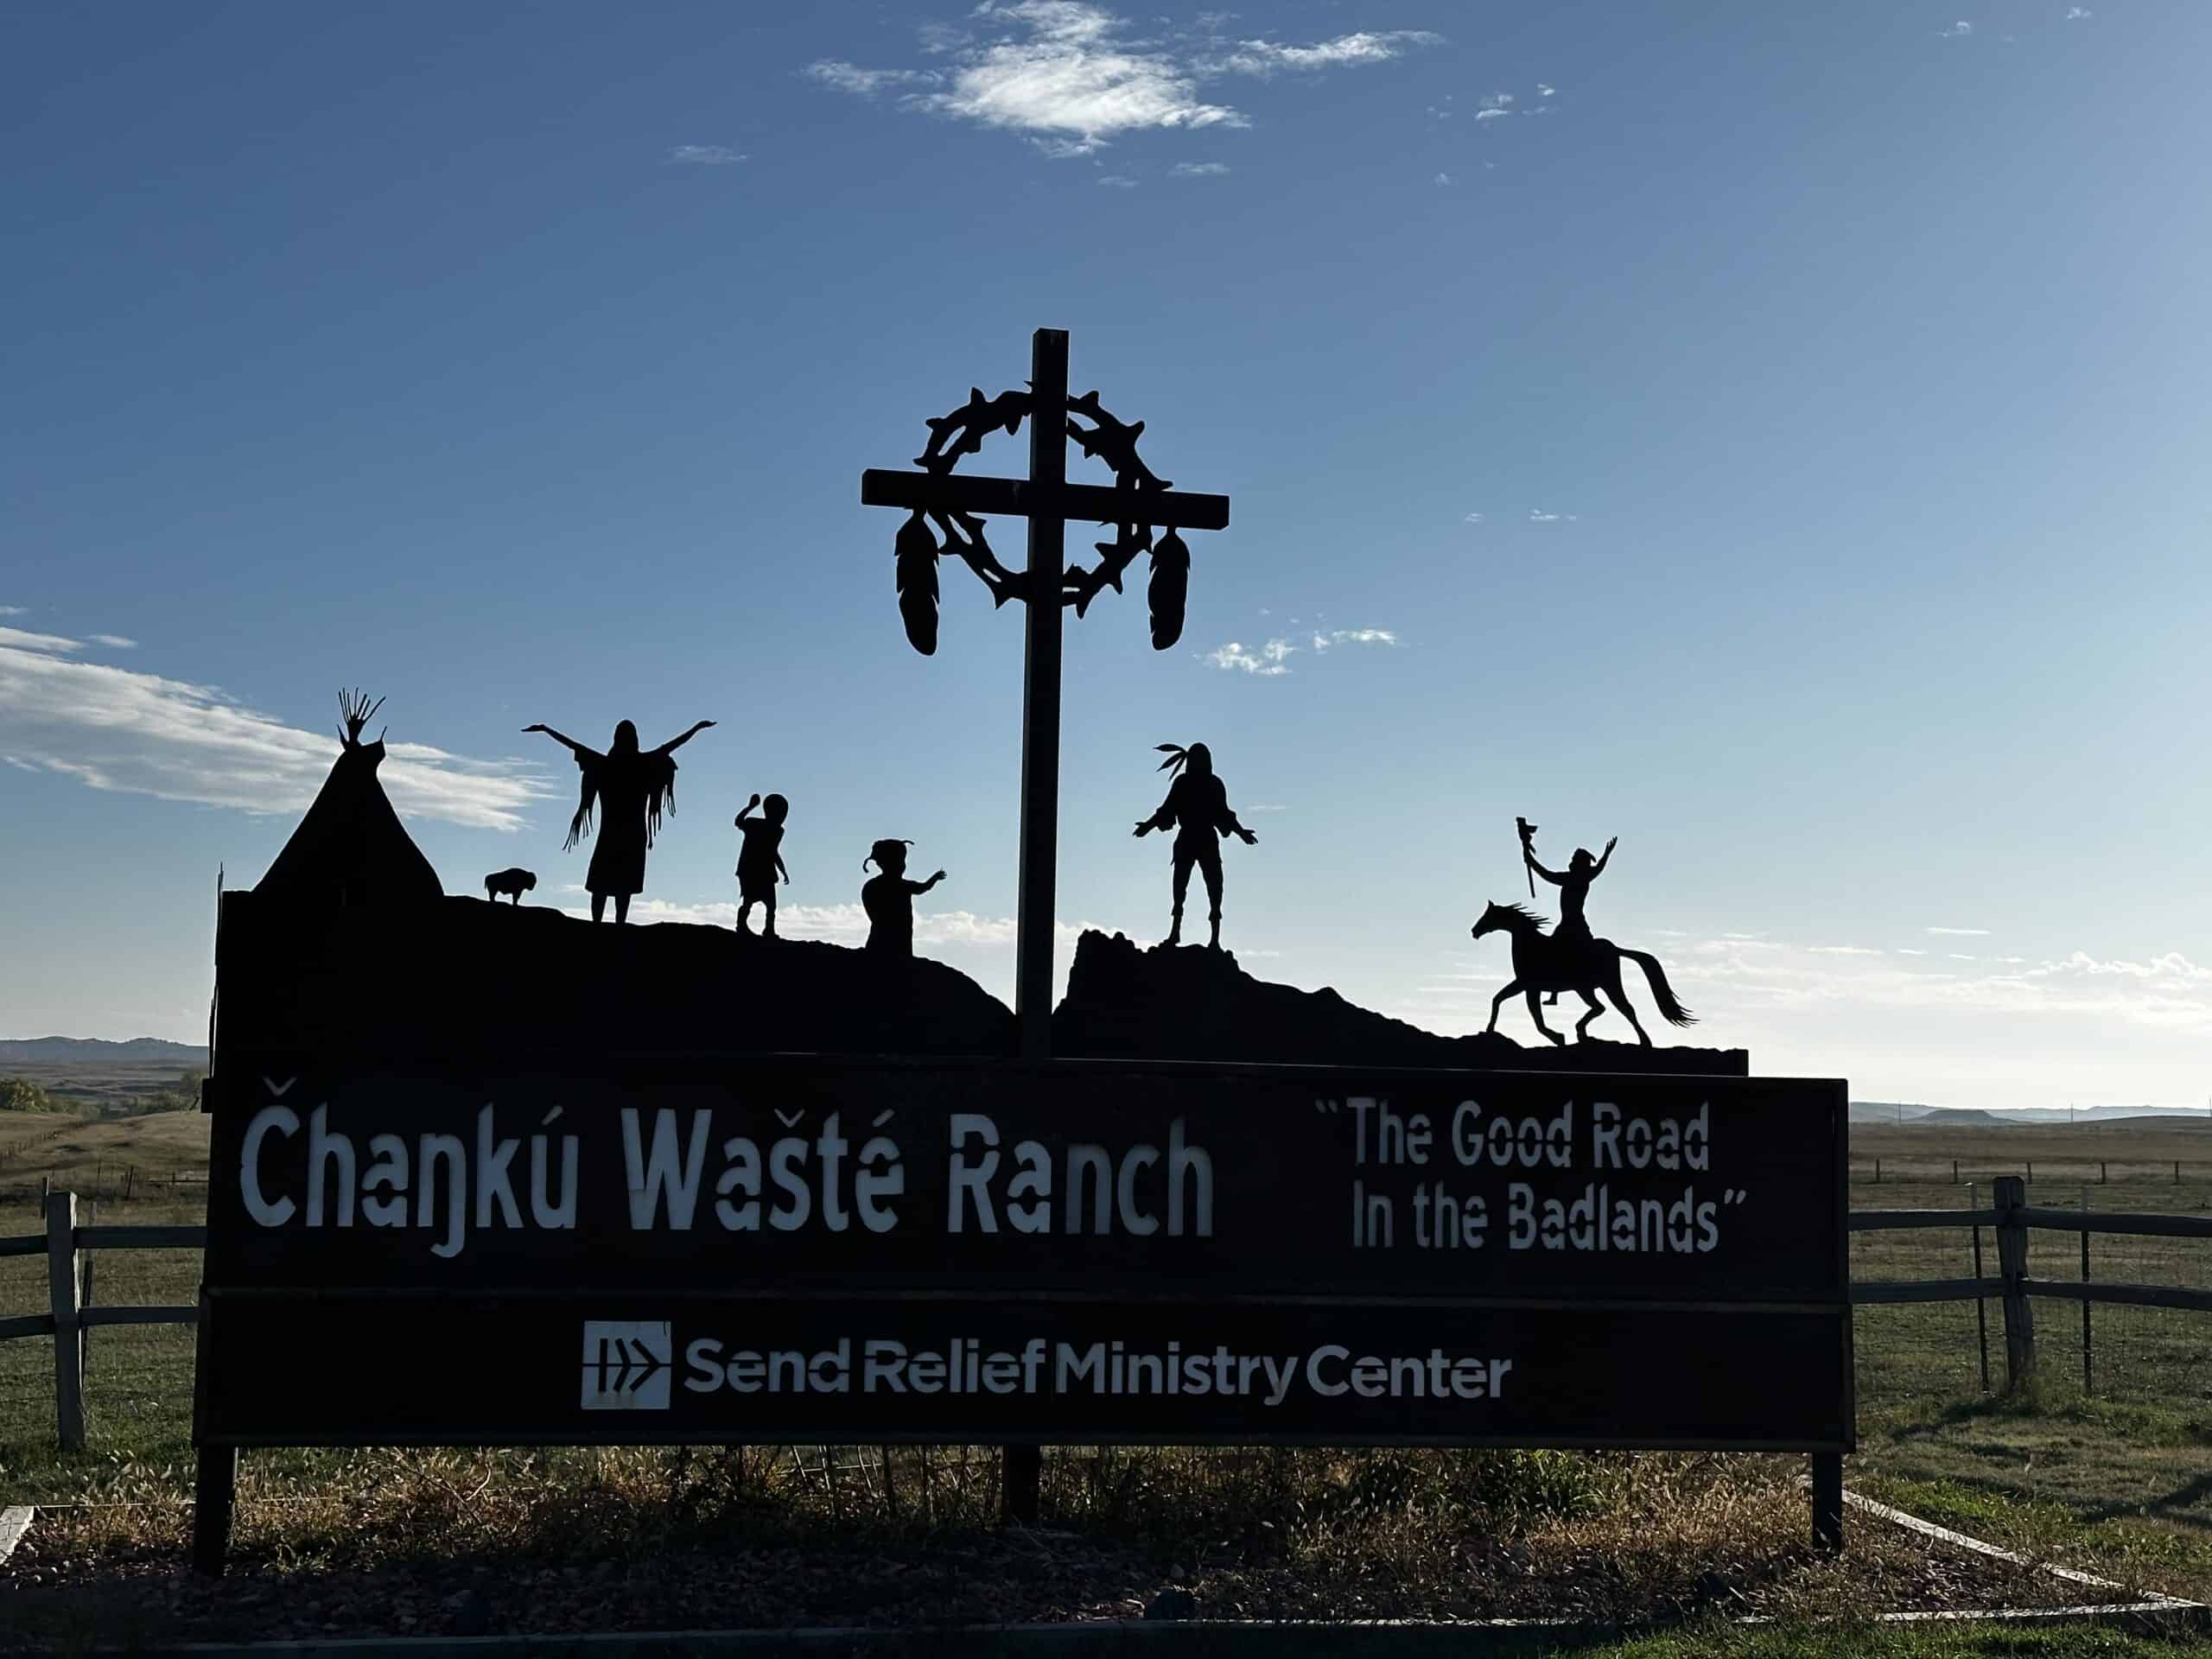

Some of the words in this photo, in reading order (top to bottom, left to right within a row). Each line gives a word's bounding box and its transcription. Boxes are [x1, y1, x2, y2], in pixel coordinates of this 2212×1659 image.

[1452, 1099, 1573, 1167] Good
[1593, 1101, 1709, 1171] Road
[948, 1113, 1214, 1236] Ranch
[1352, 1180, 1394, 1248] In
[1412, 1180, 1487, 1249] the
[683, 1337, 850, 1394] Send
[864, 1338, 1046, 1394] Relief
[1056, 1339, 1299, 1407] Ministry
[1306, 1344, 1512, 1399] Center
